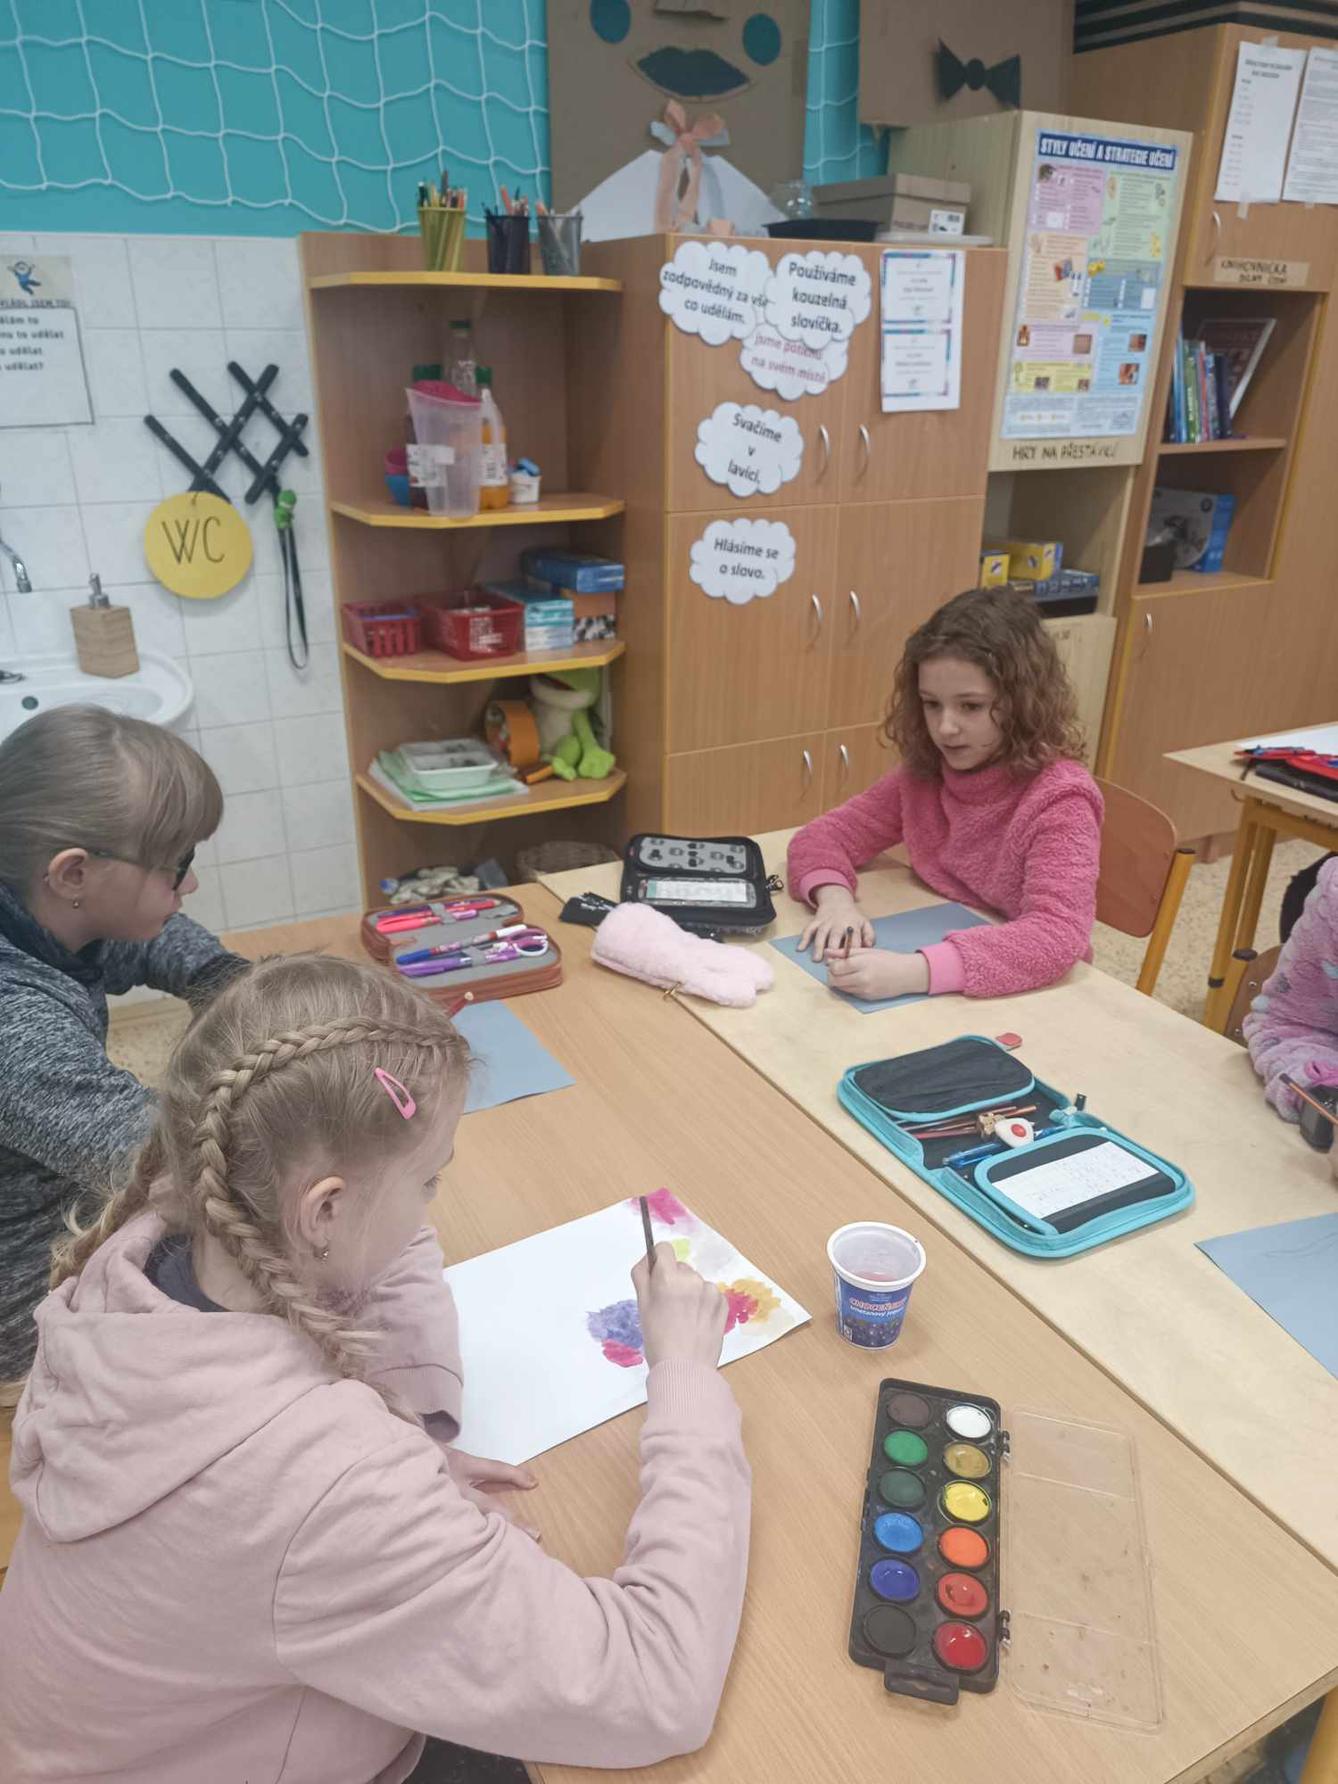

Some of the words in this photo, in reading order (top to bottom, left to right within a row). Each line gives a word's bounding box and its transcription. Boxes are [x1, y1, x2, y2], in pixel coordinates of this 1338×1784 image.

[1040, 138, 1069, 155] STYLY
[1068, 139, 1097, 158] UČENÍ
[1097, 145, 1104, 159] A
[1105, 146, 1148, 165] STRATEGIE
[788, 261, 857, 286] Používáme
[663, 270, 733, 300] zodpovědný
[736, 291, 748, 302] za
[684, 300, 698, 311] co
[792, 287, 848, 310] kouzelná
[791, 313, 842, 333] slovíčka.
[732, 412, 782, 443] Svačíme
[748, 446, 756, 456] v
[161, 515, 226, 565] WC
[714, 538, 762, 558] Hlásíme
[765, 548, 780, 559] se
[719, 563, 728, 574] o
[731, 562, 766, 580] slovo.
